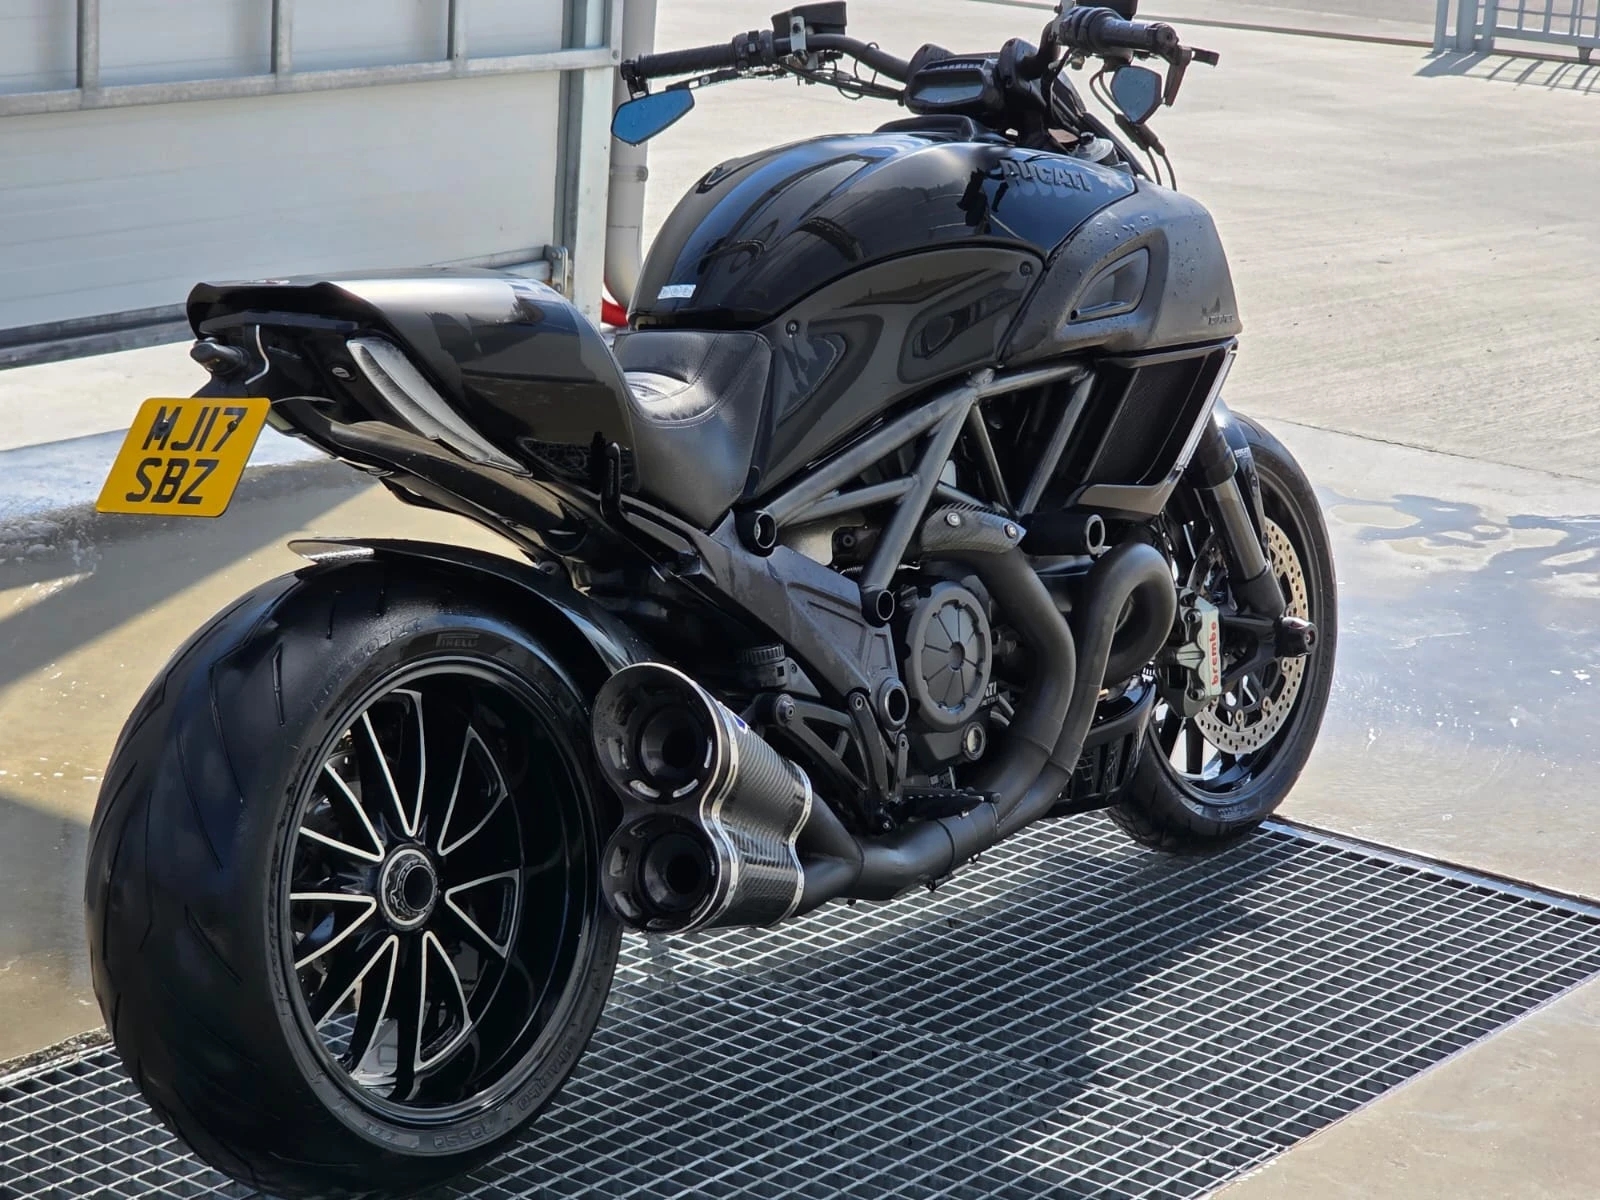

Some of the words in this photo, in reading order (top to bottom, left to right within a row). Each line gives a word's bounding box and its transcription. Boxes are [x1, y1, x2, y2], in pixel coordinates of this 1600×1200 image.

[1001, 160, 1092, 192] DUCATI
[141, 406, 249, 452] MJ17
[125, 457, 220, 505] SBZ
[1210, 621, 1219, 687] brembo
